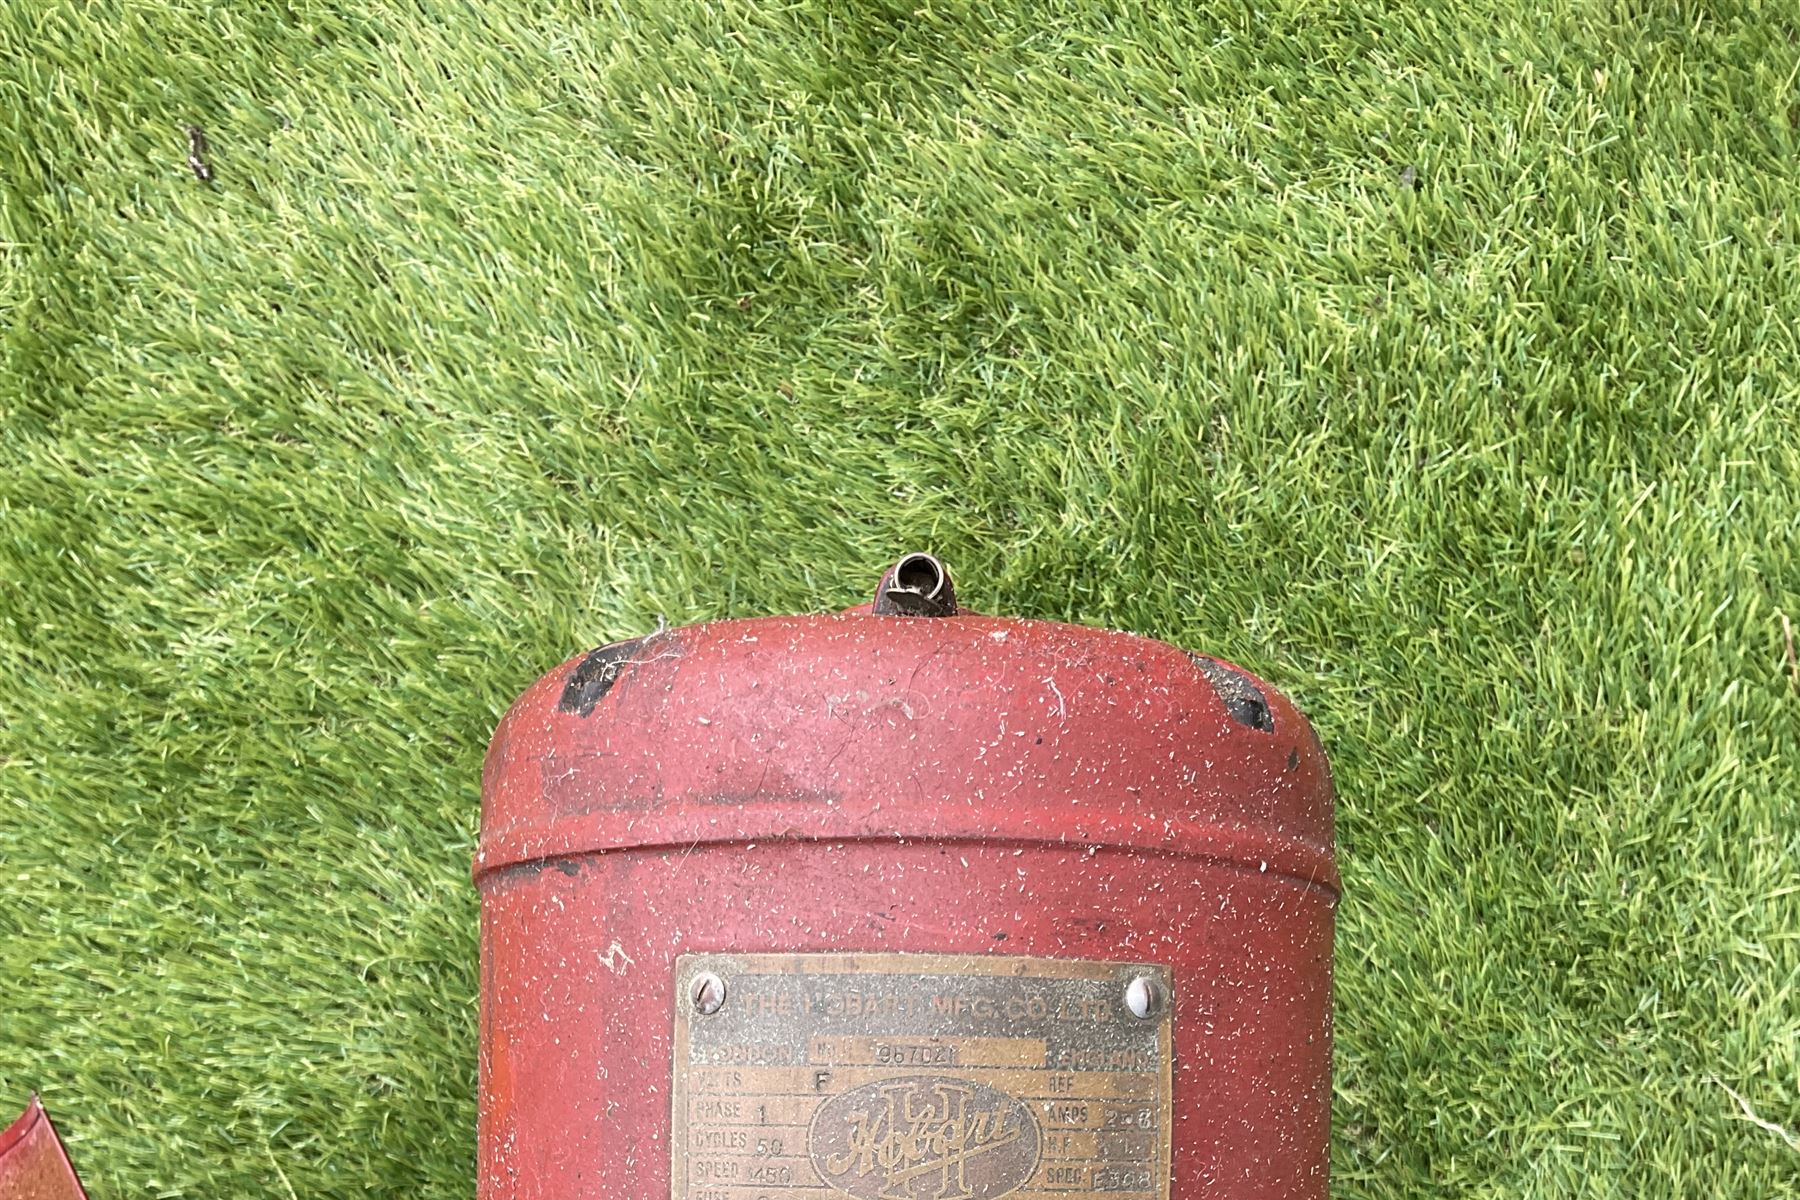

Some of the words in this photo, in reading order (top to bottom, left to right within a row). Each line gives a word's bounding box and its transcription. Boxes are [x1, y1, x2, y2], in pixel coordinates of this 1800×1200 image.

[745, 993, 792, 1015] THE
[695, 1101, 741, 1119] PHASE
[1048, 1106, 1088, 1124] AMPS
[695, 1131, 748, 1149] CYCLES
[826, 1098, 1023, 1180] Hobart
[695, 1161, 739, 1179] SPEED
